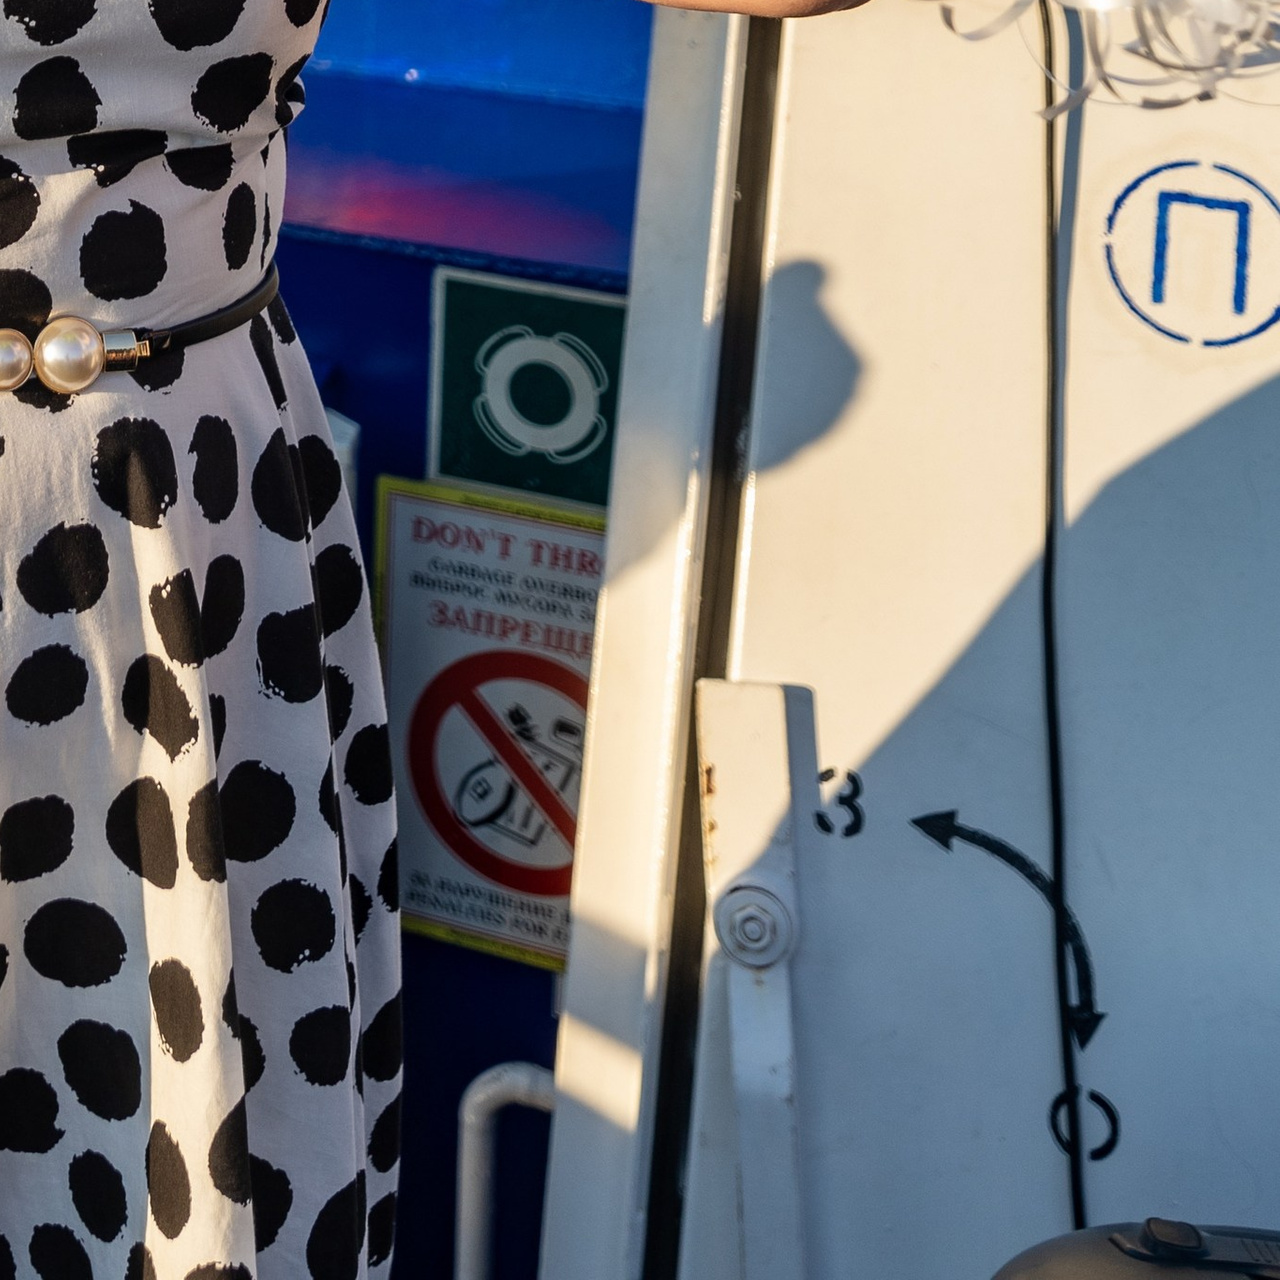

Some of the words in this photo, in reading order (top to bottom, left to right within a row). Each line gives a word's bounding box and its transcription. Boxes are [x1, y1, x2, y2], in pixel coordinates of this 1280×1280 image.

[411, 515, 517, 560] DON'T
[527, 538, 605, 576] THR
[428, 556, 516, 587] GARBAGE
